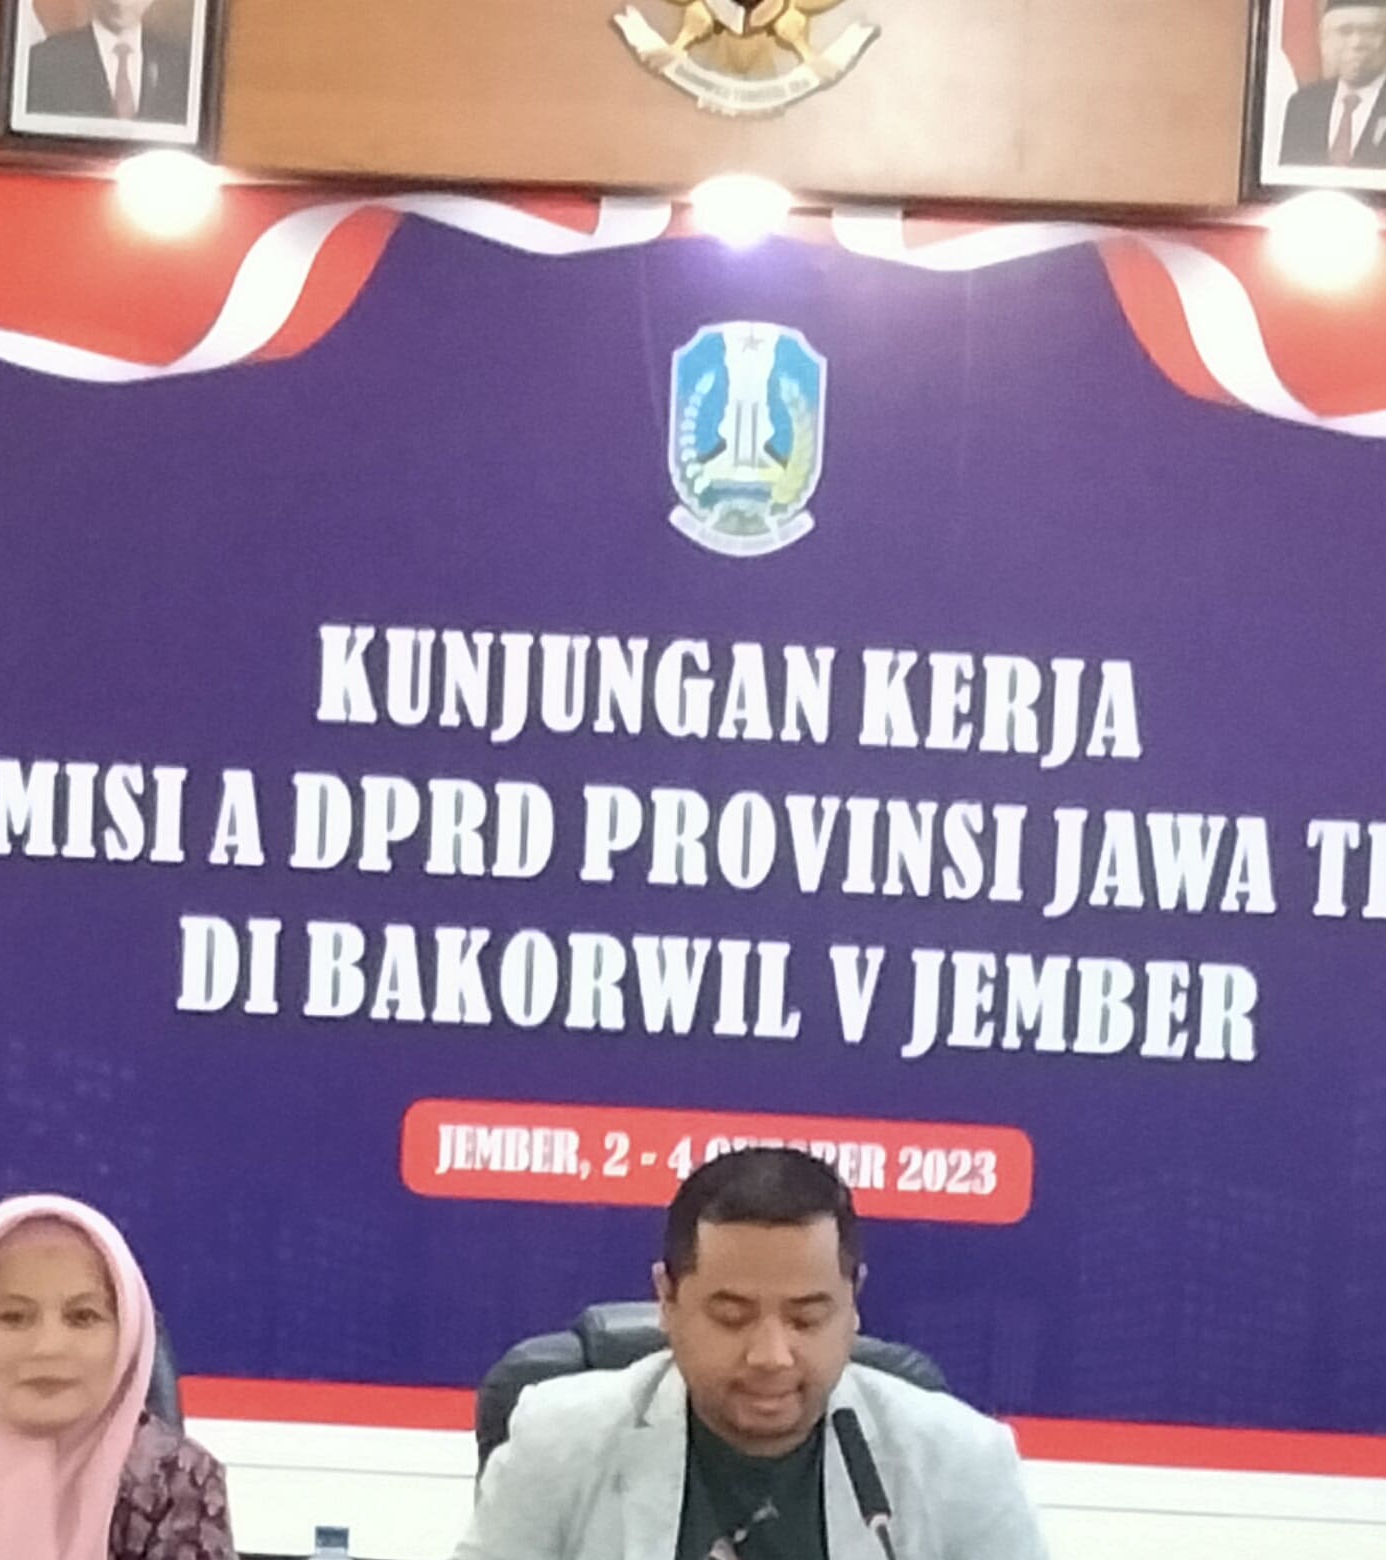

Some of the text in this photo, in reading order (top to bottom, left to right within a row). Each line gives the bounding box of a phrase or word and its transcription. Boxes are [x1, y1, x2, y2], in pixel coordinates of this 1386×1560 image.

[316, 624, 1142, 768] KUNJUNGAN KERJA
[208, 768, 265, 866] A
[289, 771, 554, 878] DPRD
[579, 784, 1027, 902] PROVINSI
[1043, 807, 1277, 918] JAWA
[176, 915, 1258, 1062] DI BAKORWIL V JEMBER
[436, 1124, 589, 1180] JEMBER,
[603, 1131, 631, 1178] 2
[667, 1136, 693, 1181] 4
[896, 1149, 998, 1195] 2023
